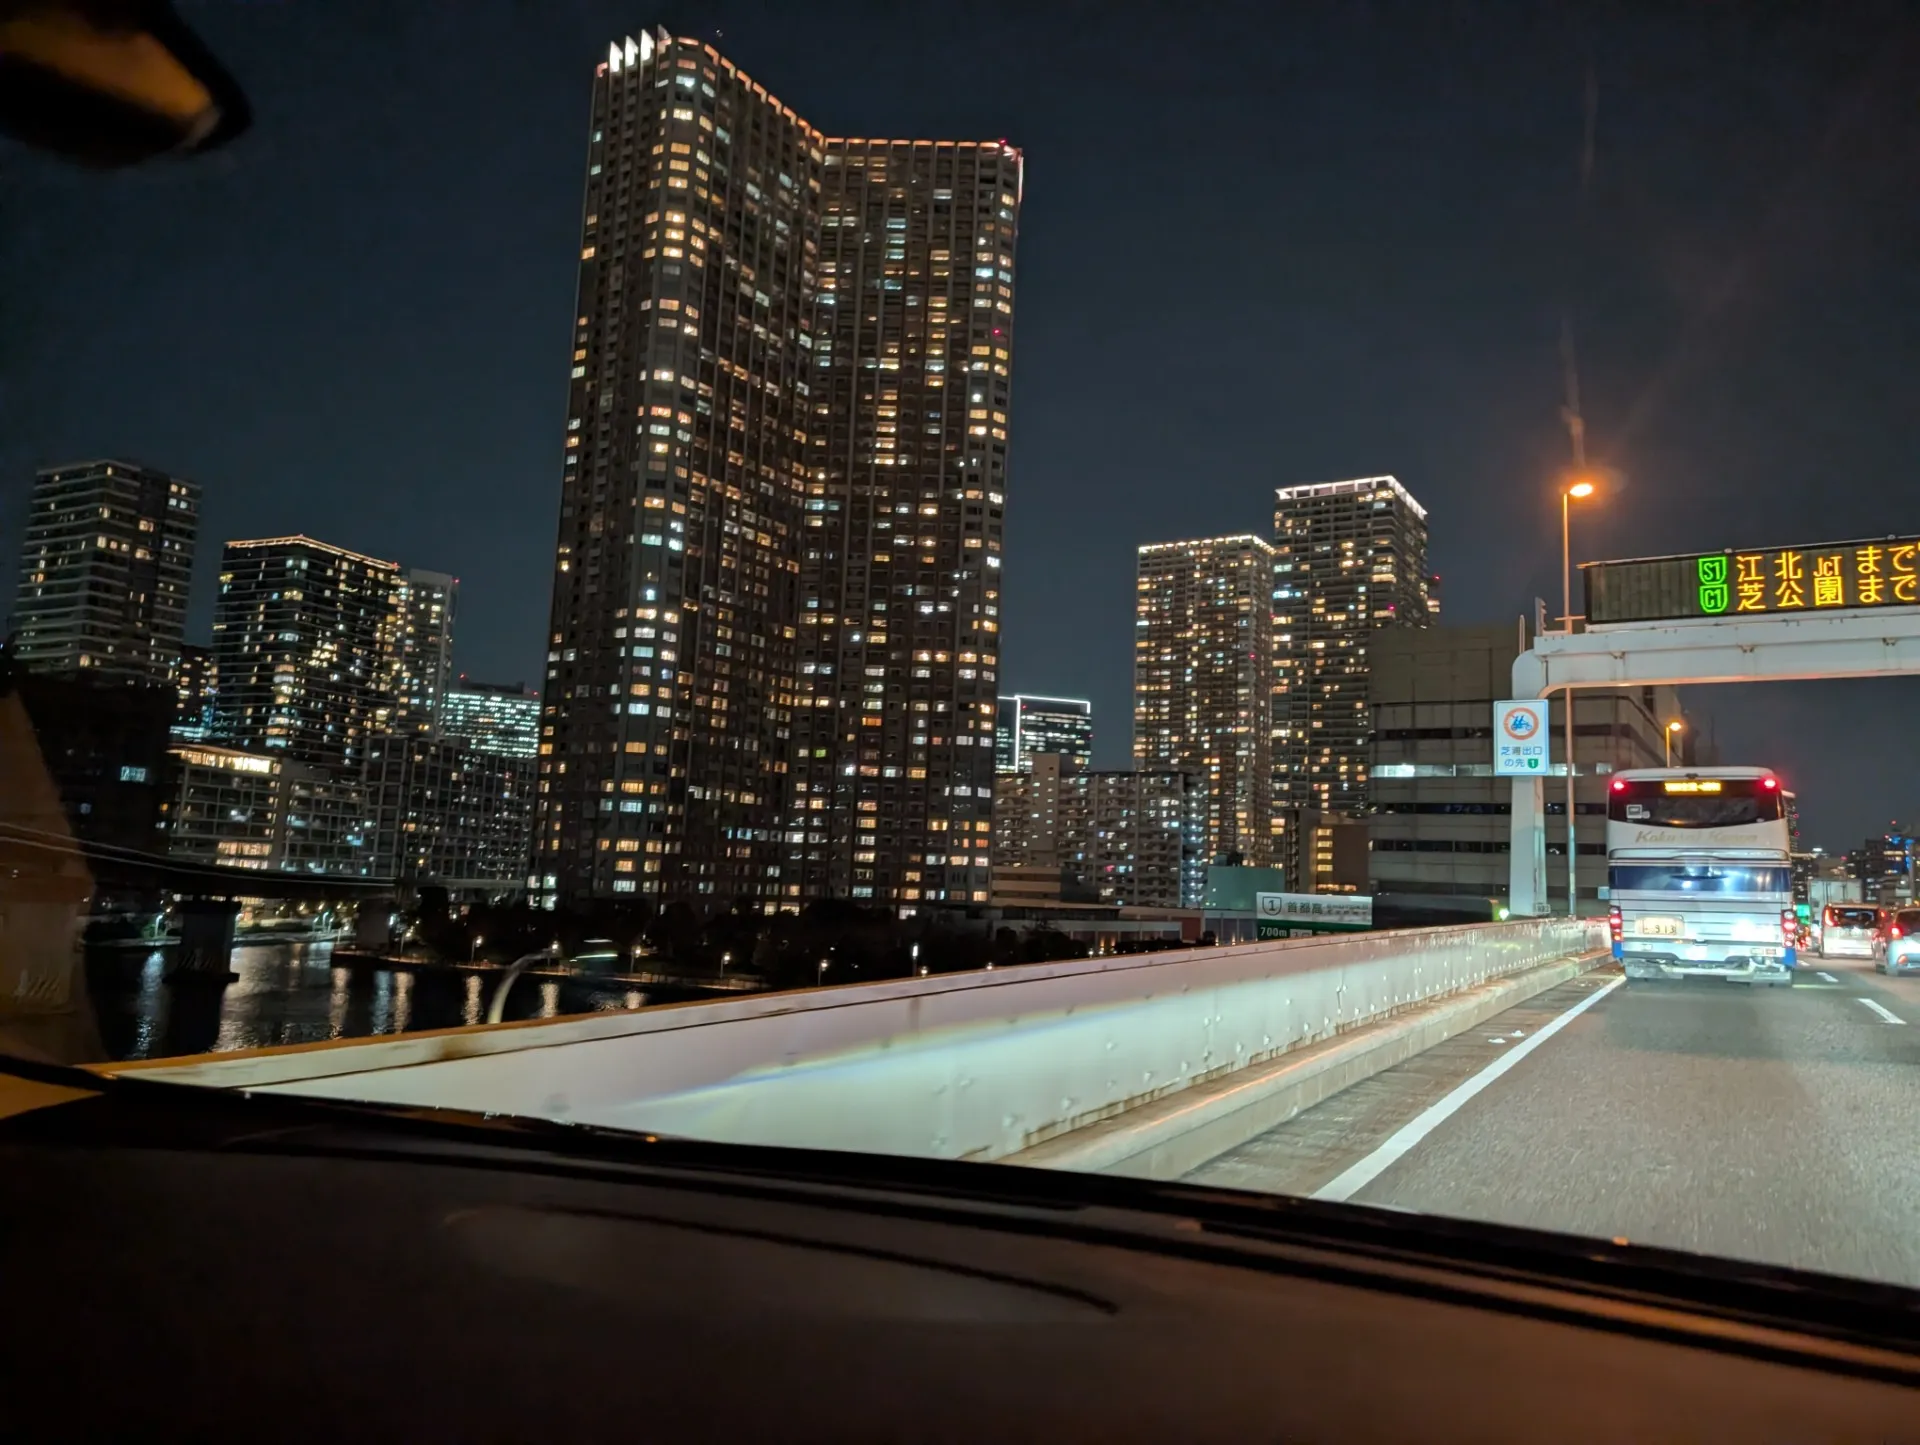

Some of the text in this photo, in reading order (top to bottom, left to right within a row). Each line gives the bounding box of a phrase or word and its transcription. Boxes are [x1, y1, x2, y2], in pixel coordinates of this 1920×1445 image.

[1737, 574, 1917, 611] 芝公園まで
[1268, 900, 1276, 912] 1
[1260, 926, 1288, 938] 700m
